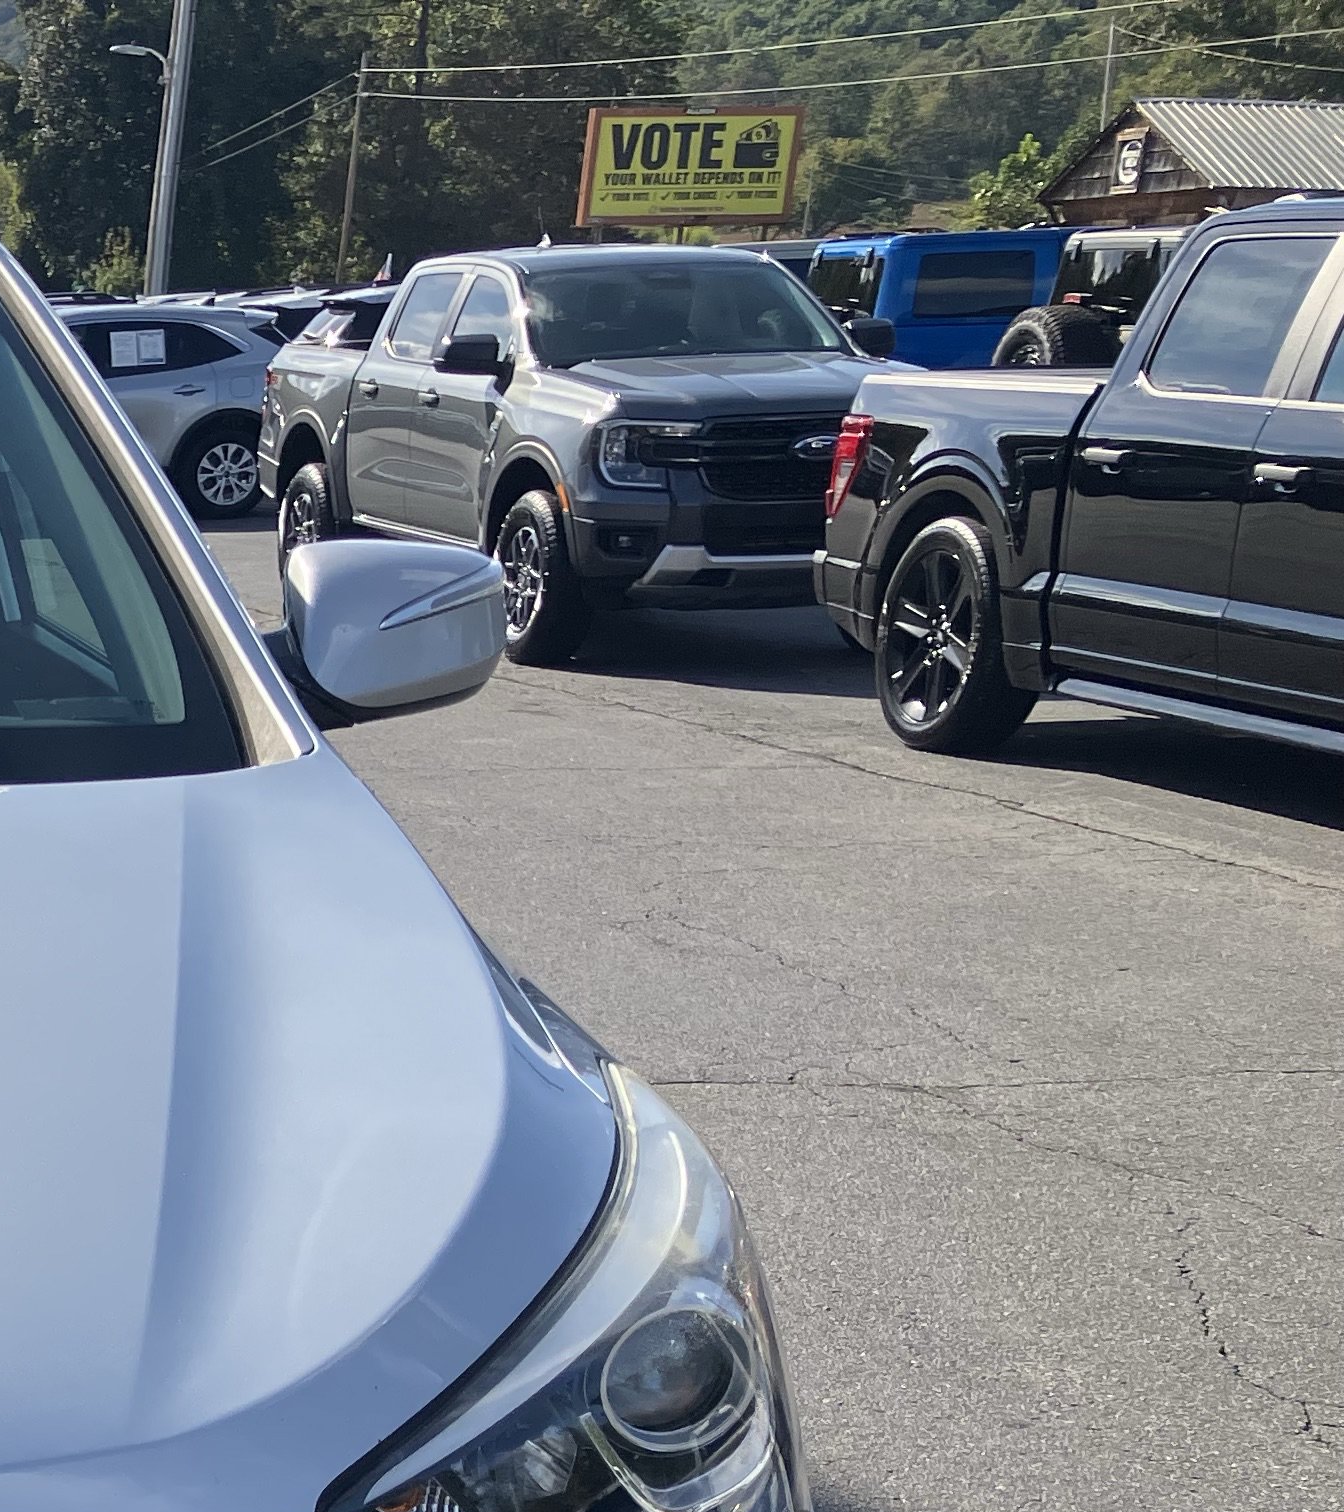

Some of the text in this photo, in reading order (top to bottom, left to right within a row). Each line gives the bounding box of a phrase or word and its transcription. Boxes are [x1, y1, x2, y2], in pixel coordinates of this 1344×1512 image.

[612, 122, 727, 170] VOTE
[604, 173, 636, 186] YOUR
[641, 172, 689, 185] WALLET
[693, 171, 744, 184] DEPENDS
